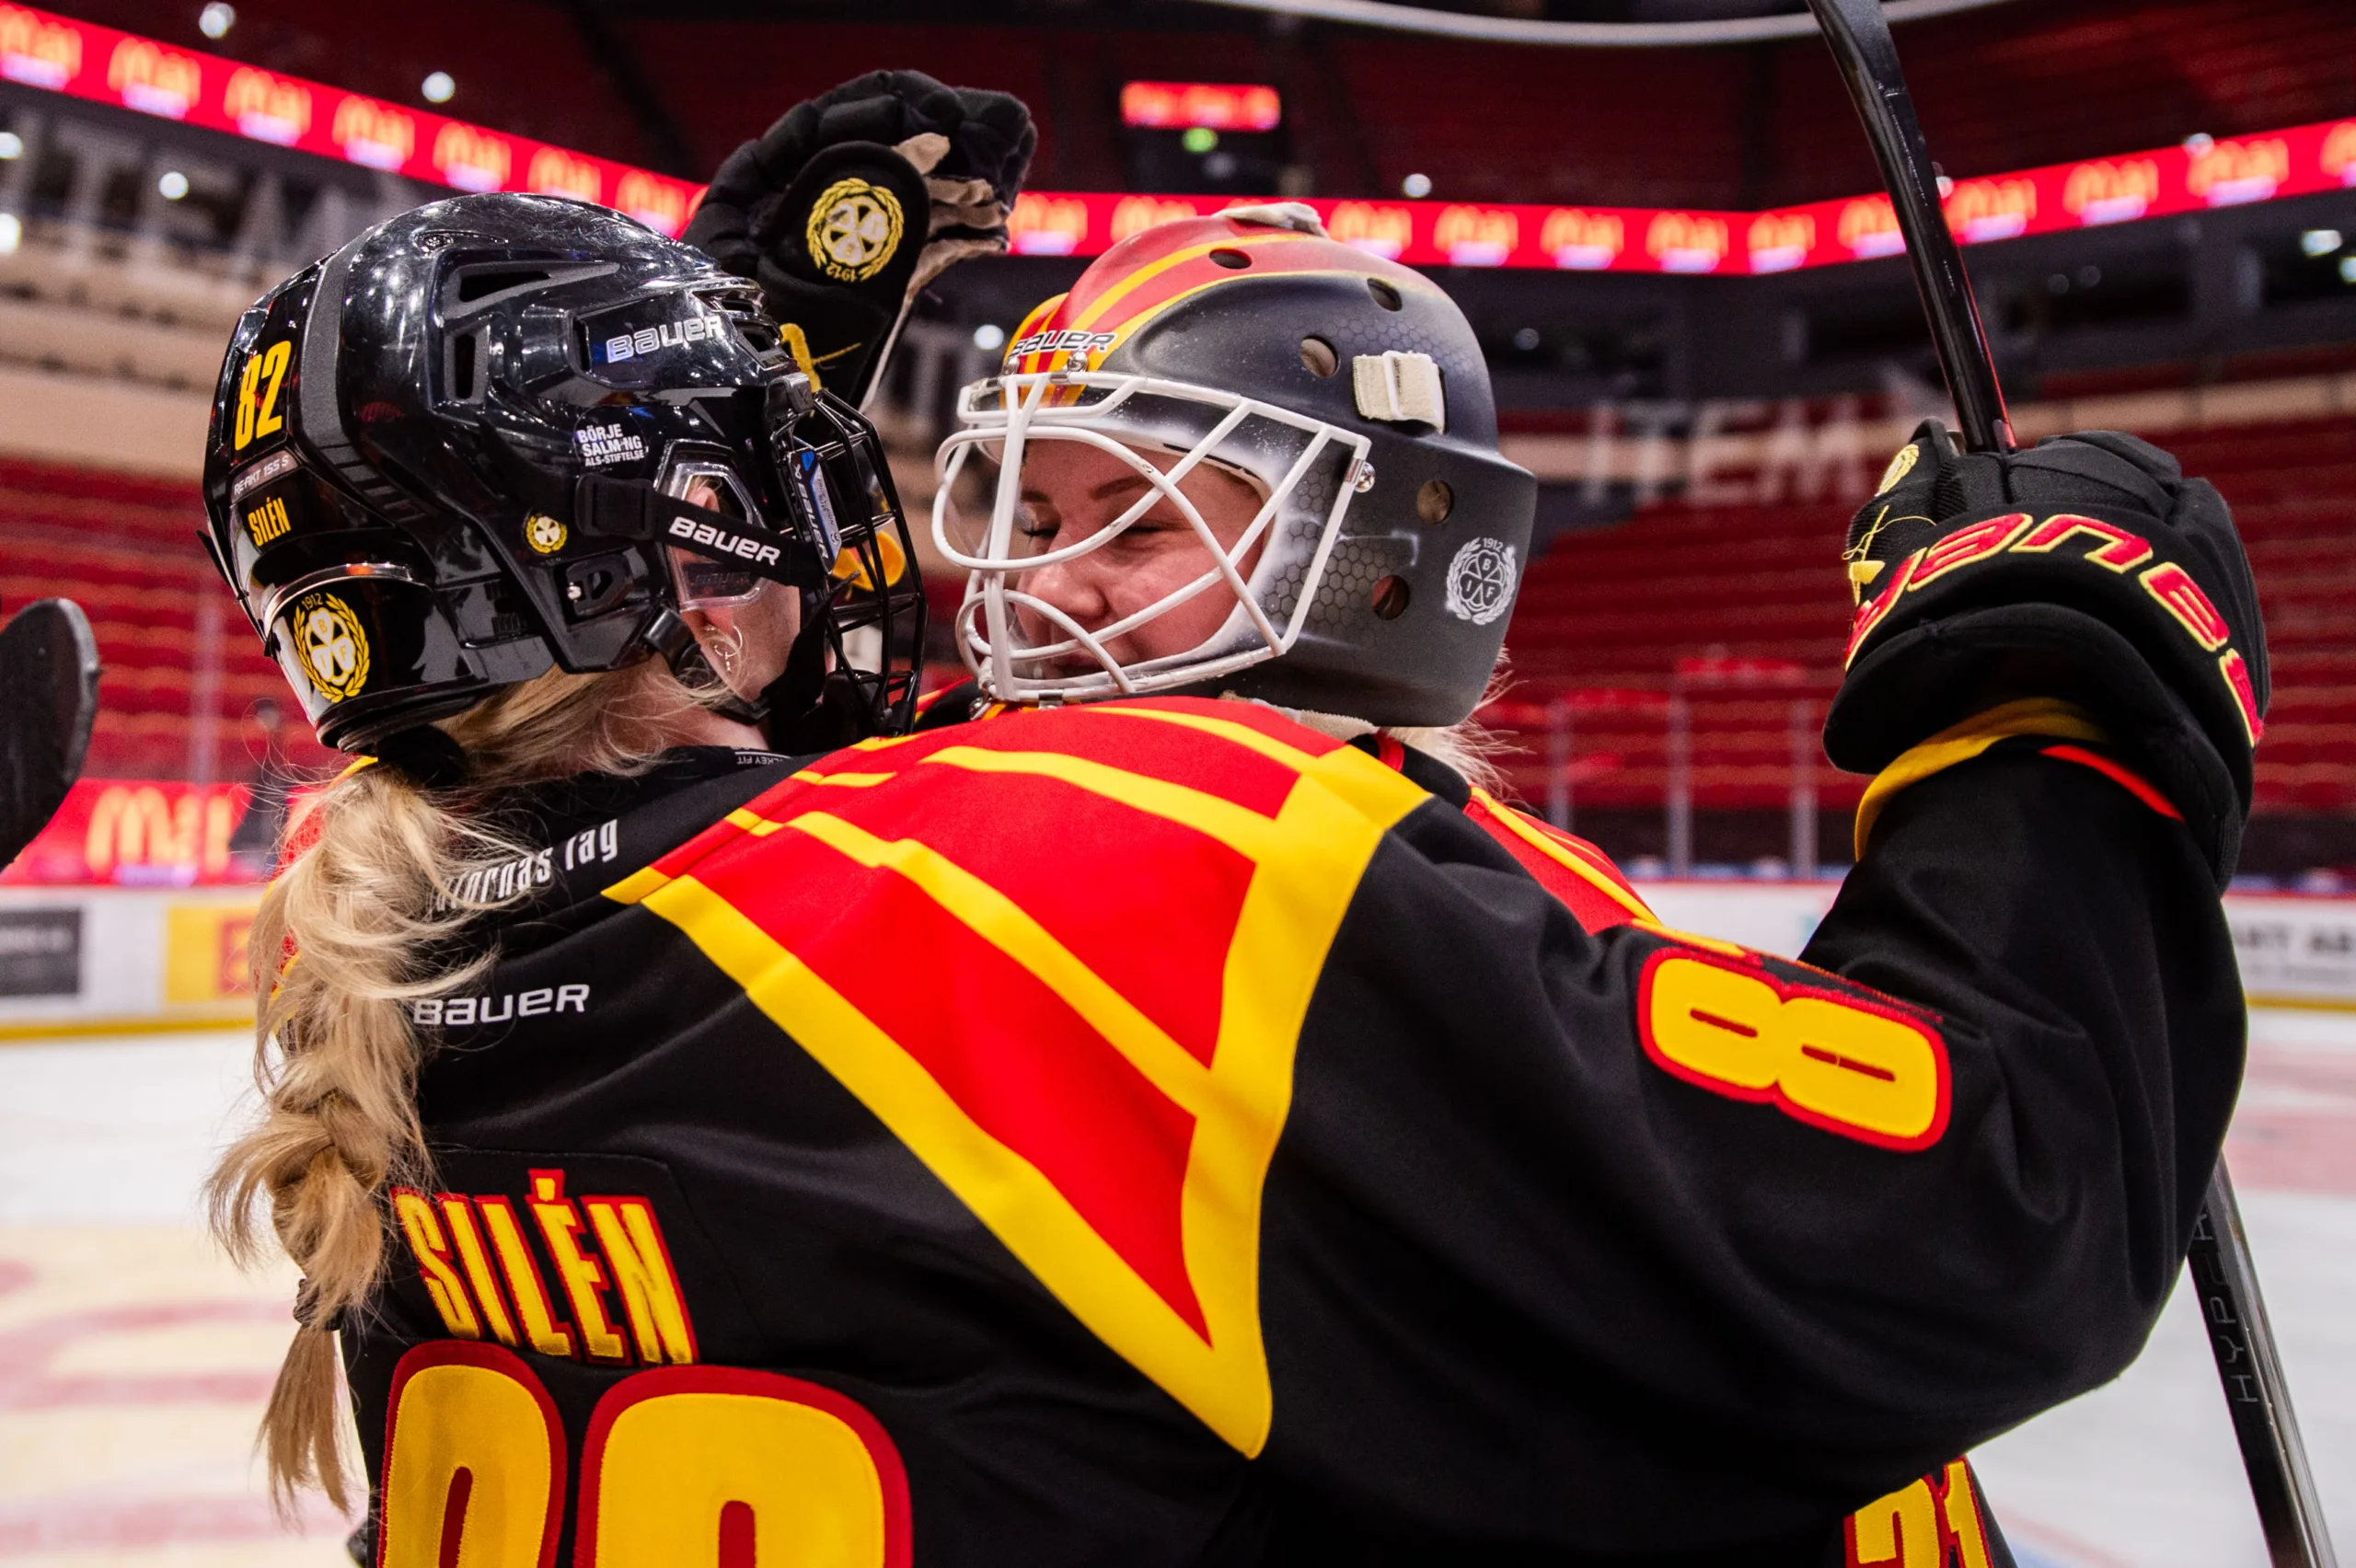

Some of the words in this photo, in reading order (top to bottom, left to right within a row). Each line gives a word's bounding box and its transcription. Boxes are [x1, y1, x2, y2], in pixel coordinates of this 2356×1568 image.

[606, 316, 726, 363] BAUER
[1010, 329, 1118, 357] BAUER
[234, 340, 292, 451] 82
[576, 422, 624, 444] BÖRJE
[263, 459, 281, 476] 155
[584, 449, 645, 467] ALS-STIFTELSE
[248, 497, 292, 548] SILÉN
[668, 515, 781, 566] BAUER
[797, 481, 829, 559] BAUER
[1482, 537, 1504, 552] 1912
[301, 593, 324, 610] 1912
[413, 983, 590, 1026] BAUER
[388, 1168, 701, 1366] SILÉN
